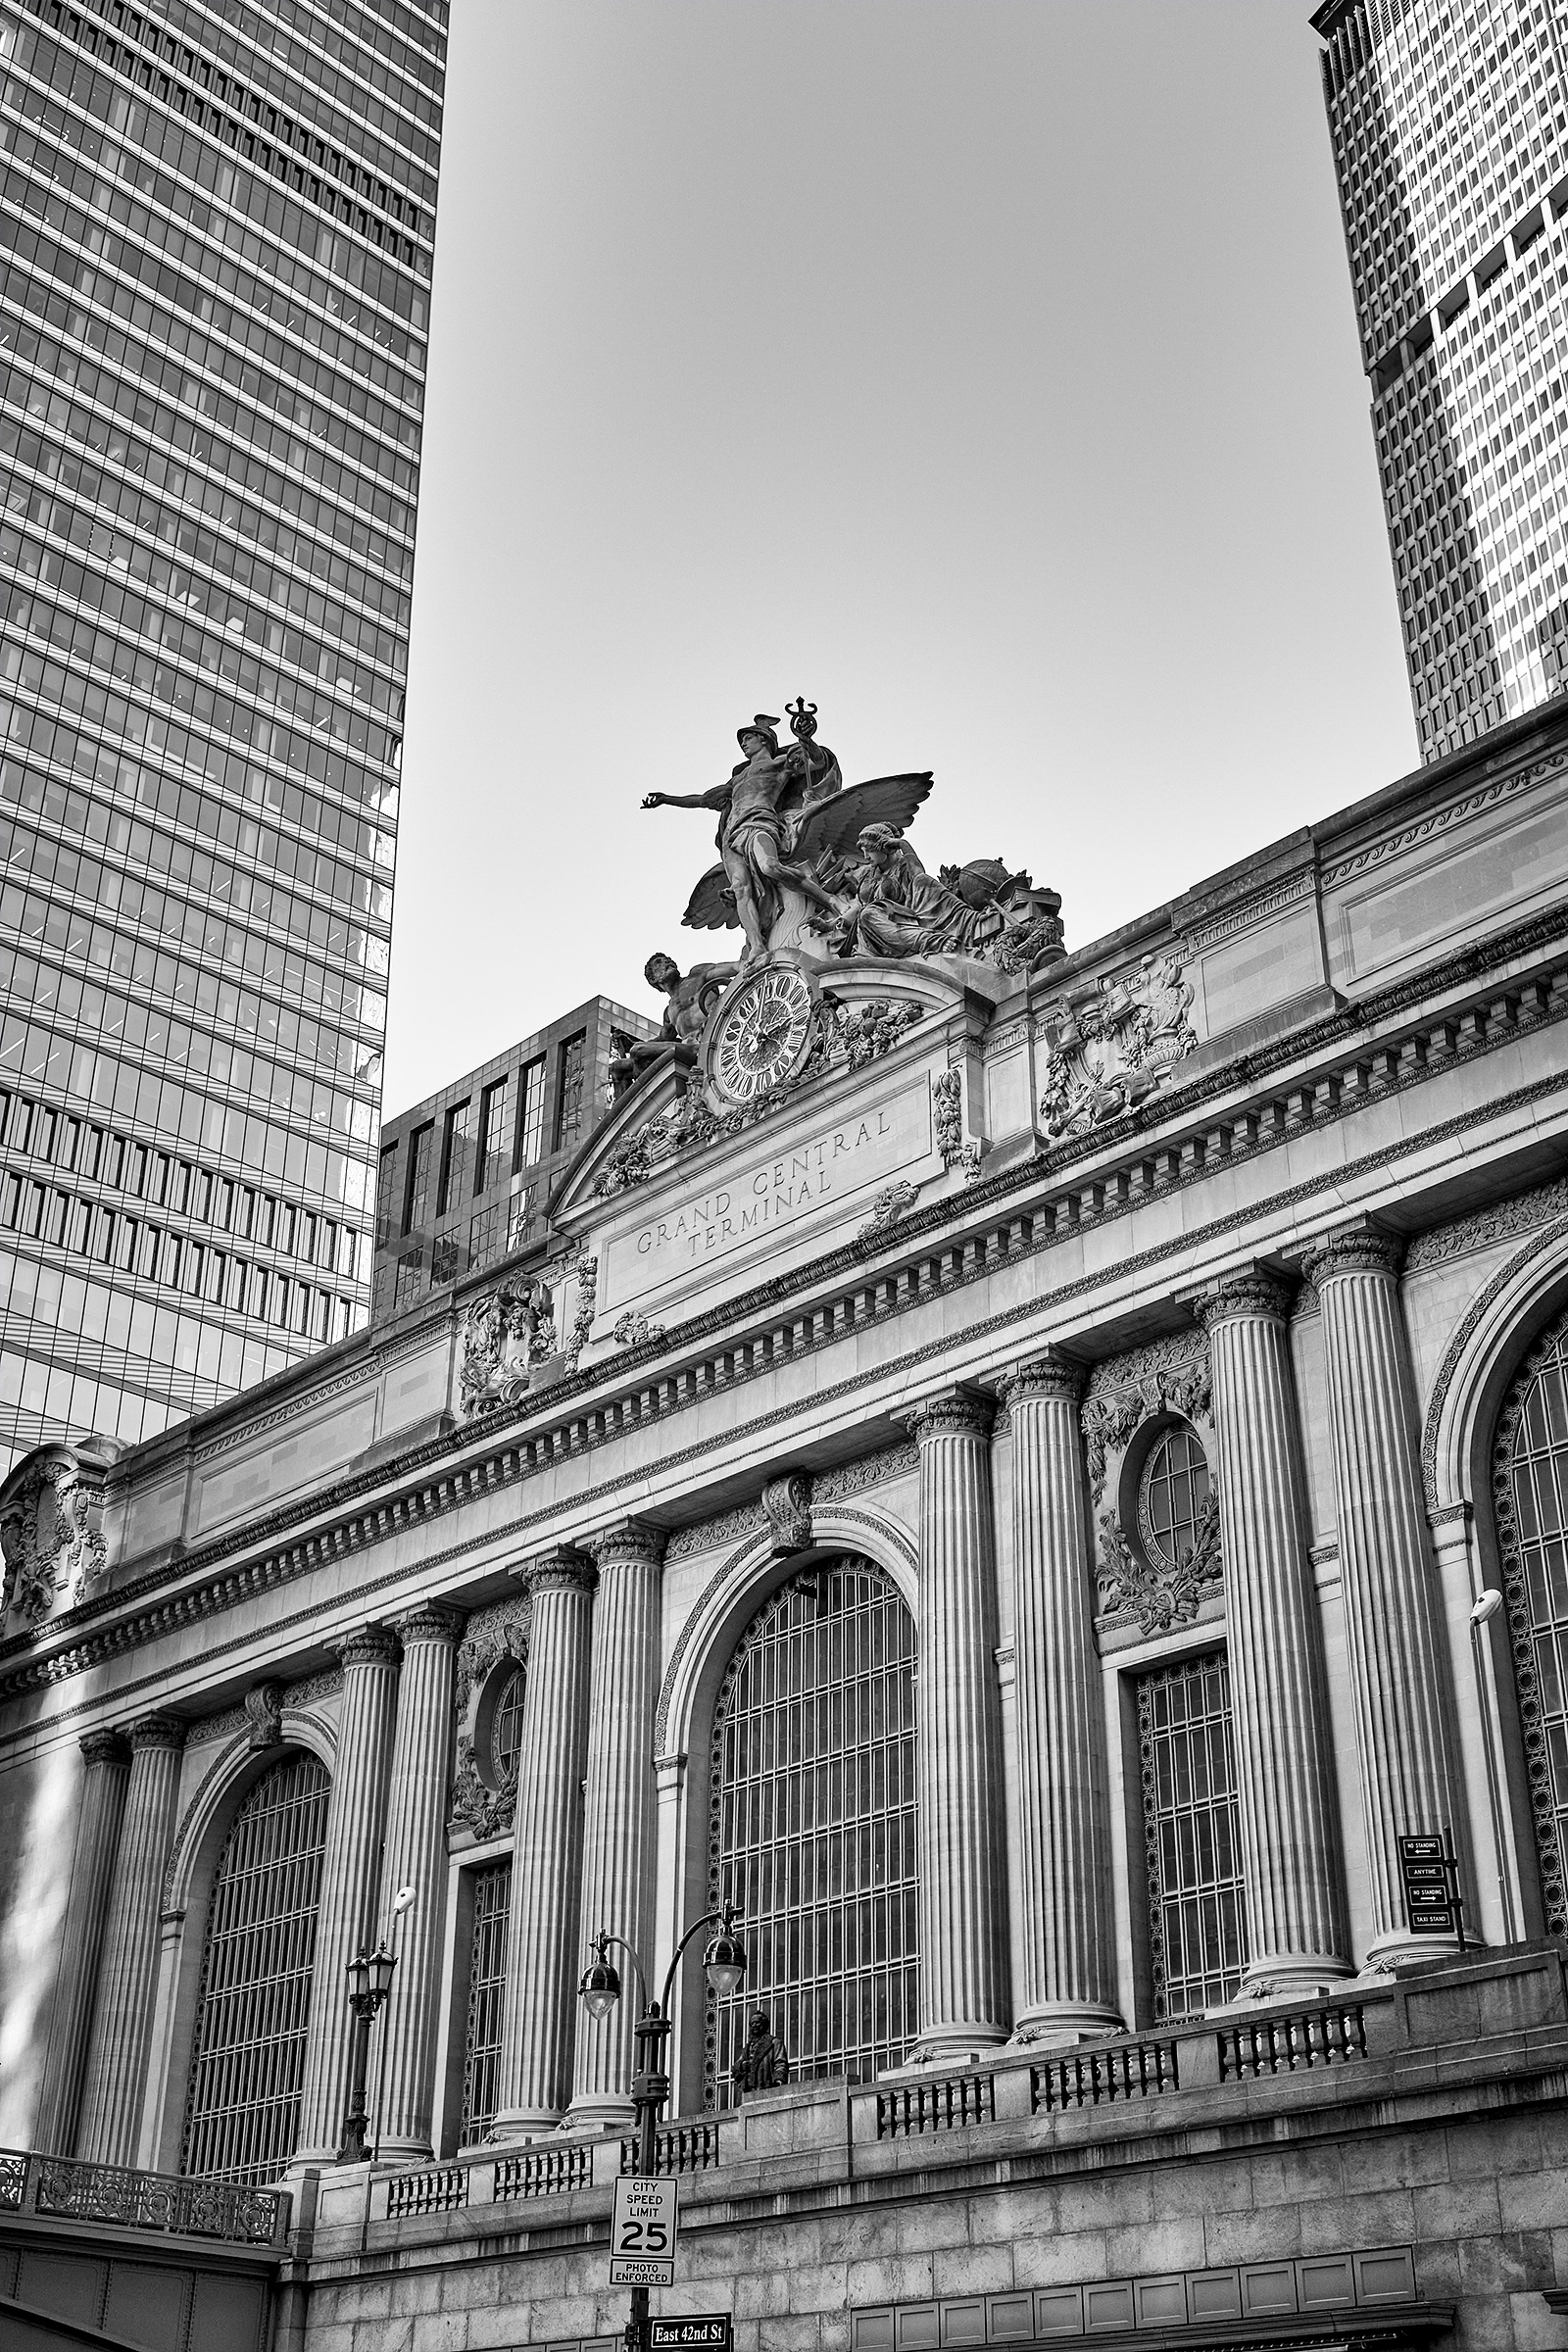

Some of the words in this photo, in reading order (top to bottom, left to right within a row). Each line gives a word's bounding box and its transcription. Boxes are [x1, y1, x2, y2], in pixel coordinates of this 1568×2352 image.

[637, 1193, 731, 1253] GRAND
[753, 1111, 891, 1195] CENTRAL
[688, 1171, 831, 1257] TERMINAL
[632, 2181, 659, 2192] CITY
[626, 2194, 663, 2205] SPEED
[629, 2207, 660, 2218] LIMIT
[619, 2221, 668, 2252] 25
[625, 2263, 659, 2273] PHOTO
[615, 2272, 668, 2283] ENFORCED
[655, 2327, 679, 2342] East
[681, 2325, 708, 2341] 42nd
[710, 2324, 723, 2340] St
